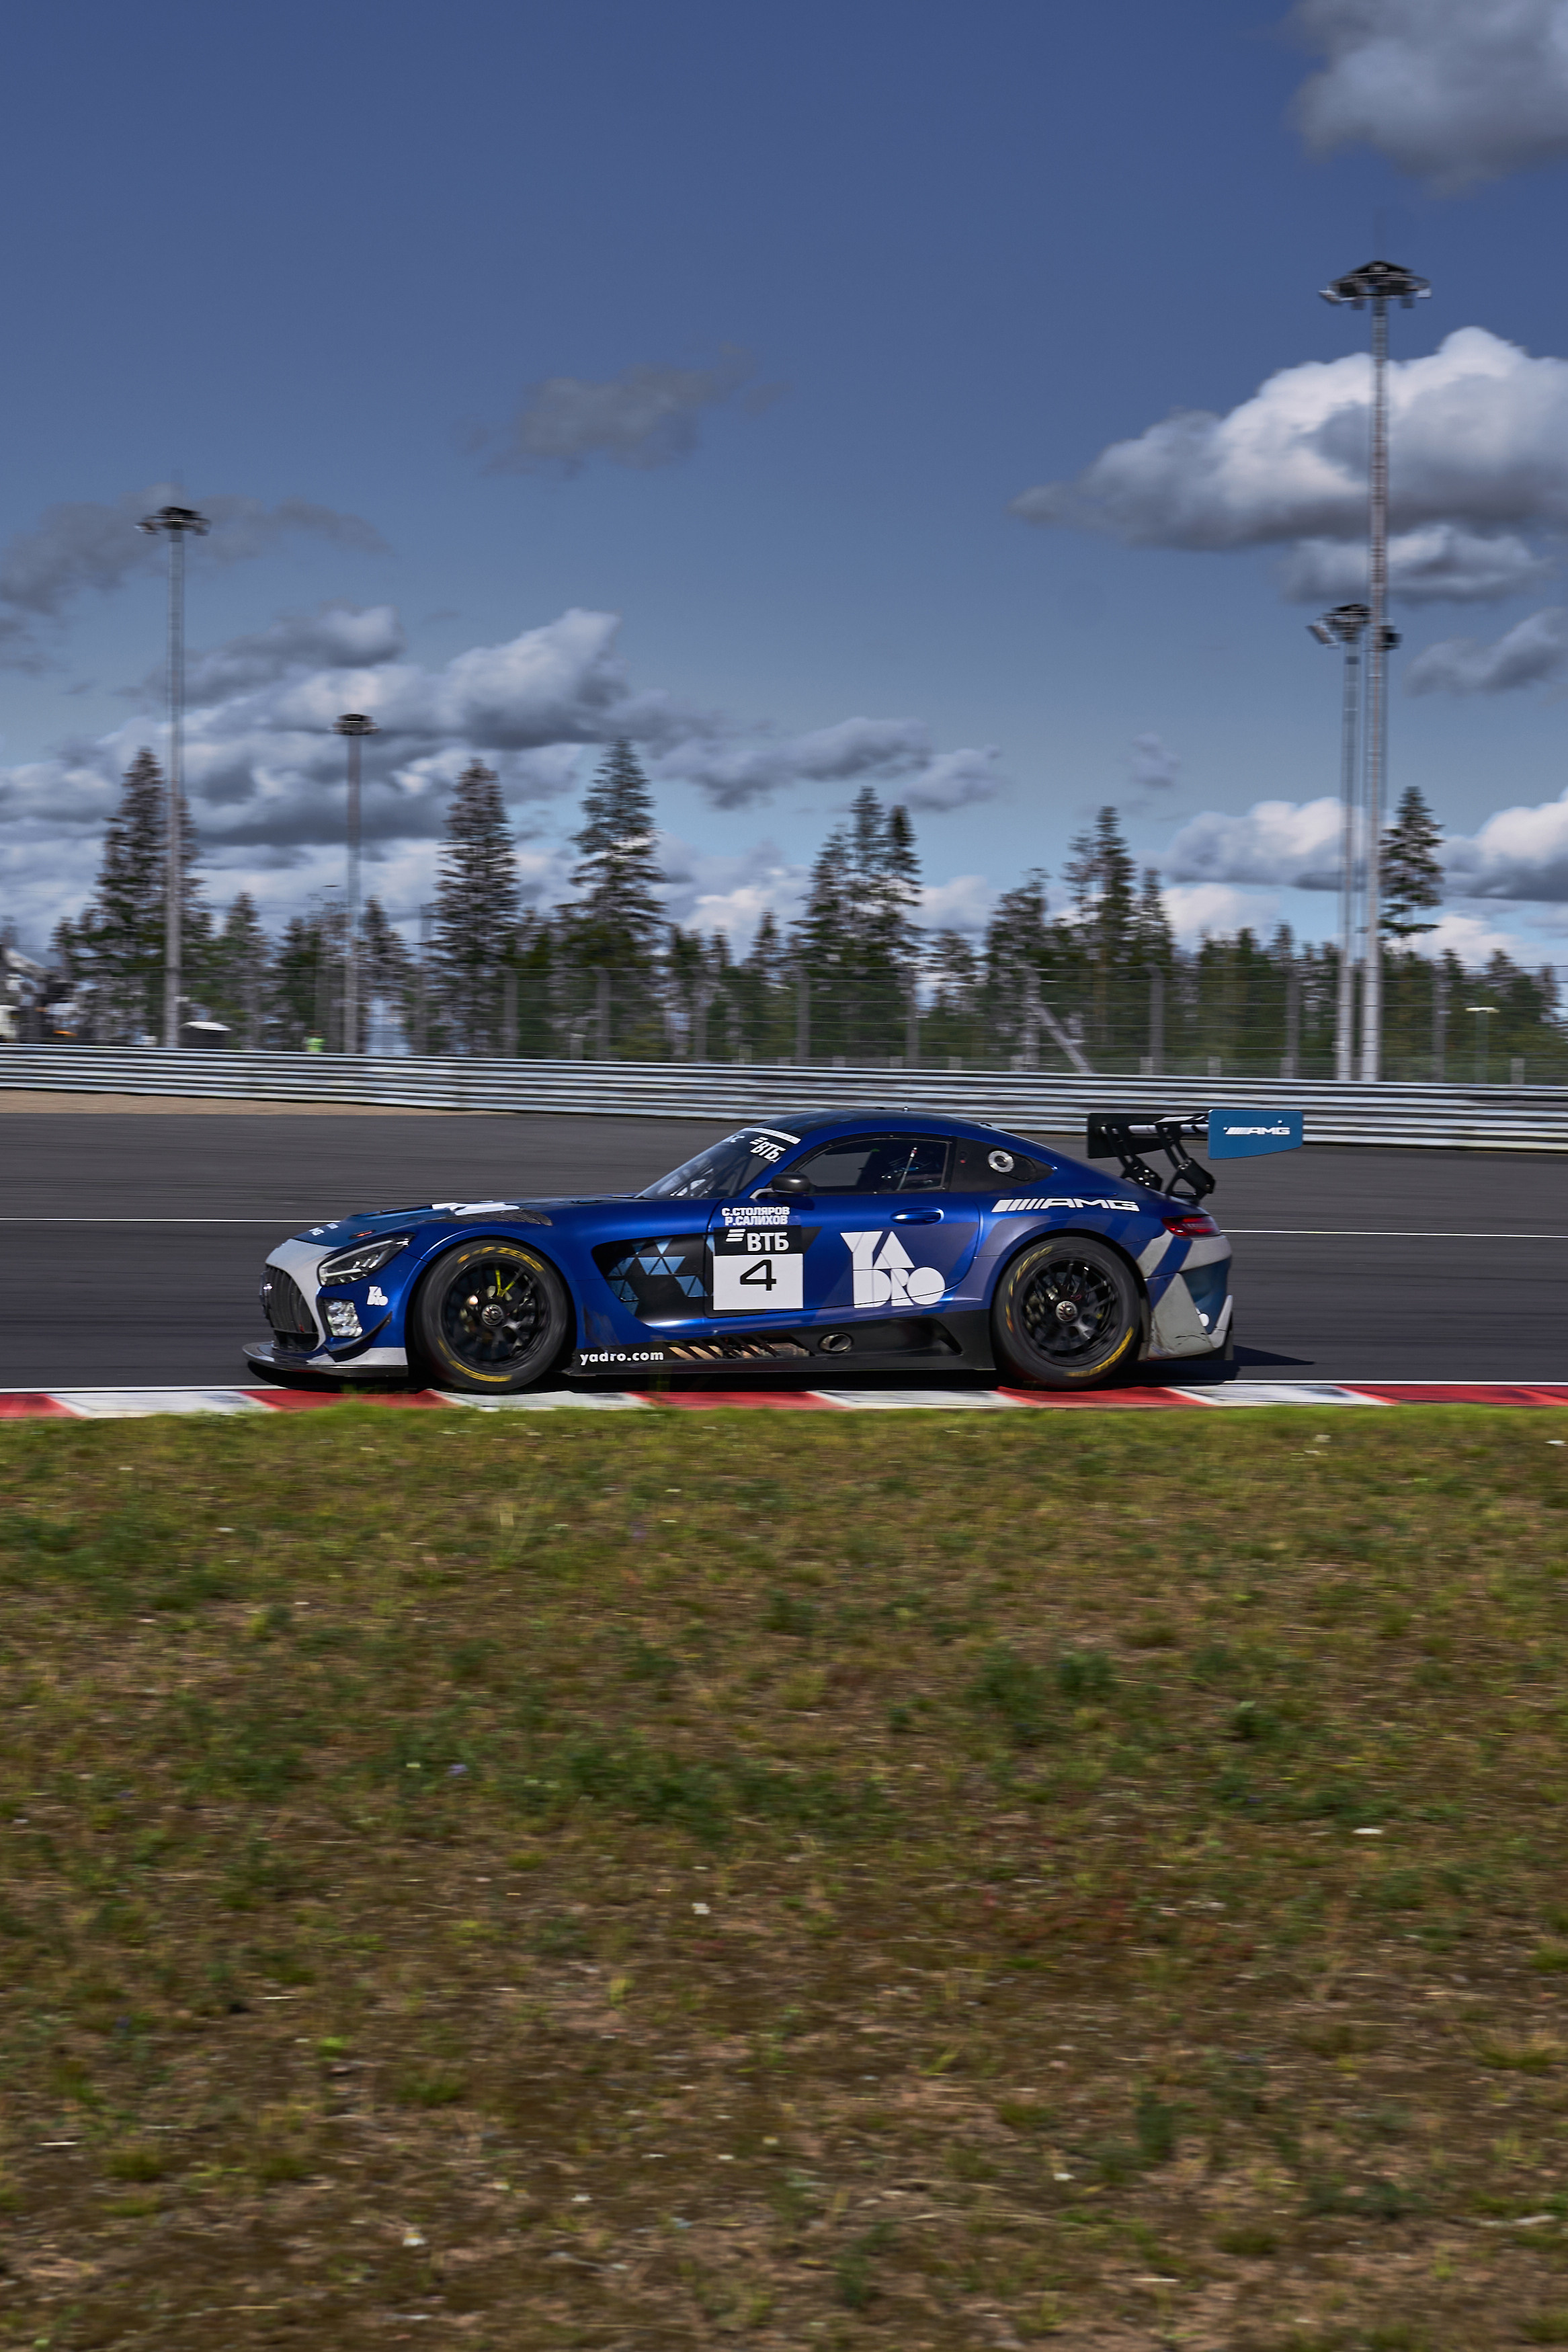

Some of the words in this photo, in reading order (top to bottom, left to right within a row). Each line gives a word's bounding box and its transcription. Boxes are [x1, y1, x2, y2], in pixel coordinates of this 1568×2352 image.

[750, 1141, 786, 1160] ВТБ
[721, 1207, 790, 1217] С.СТОЛЯРОВ
[1040, 1198, 1140, 1212] AMG
[725, 1215, 788, 1226] Р.САЛИХОВ
[747, 1231, 790, 1252] ВТБ
[740, 1259, 777, 1291] 4
[580, 1351, 664, 1366] yadro.com
